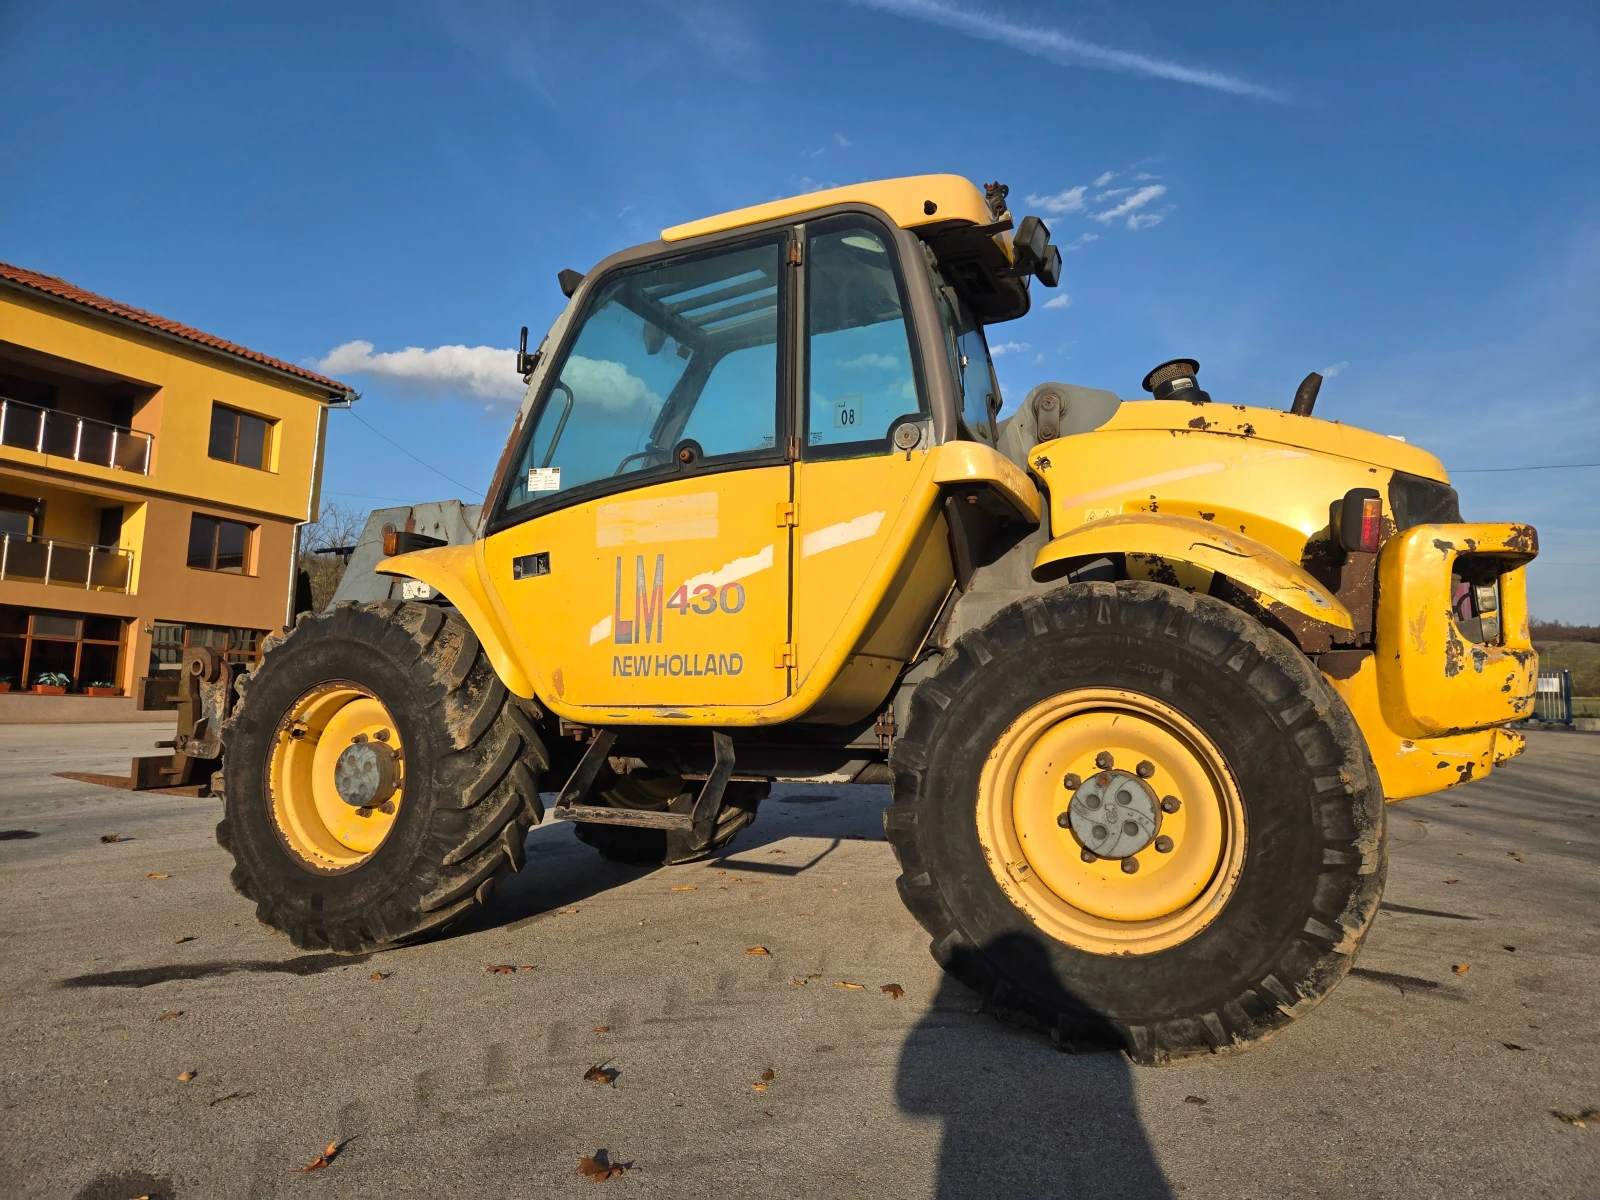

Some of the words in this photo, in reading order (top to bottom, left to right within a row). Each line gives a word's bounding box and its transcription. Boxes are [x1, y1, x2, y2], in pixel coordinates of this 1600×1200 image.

[614, 553, 664, 644] LM
[666, 582, 746, 616] 430
[612, 654, 652, 677] NEW
[654, 652, 744, 676] HOLLAND
